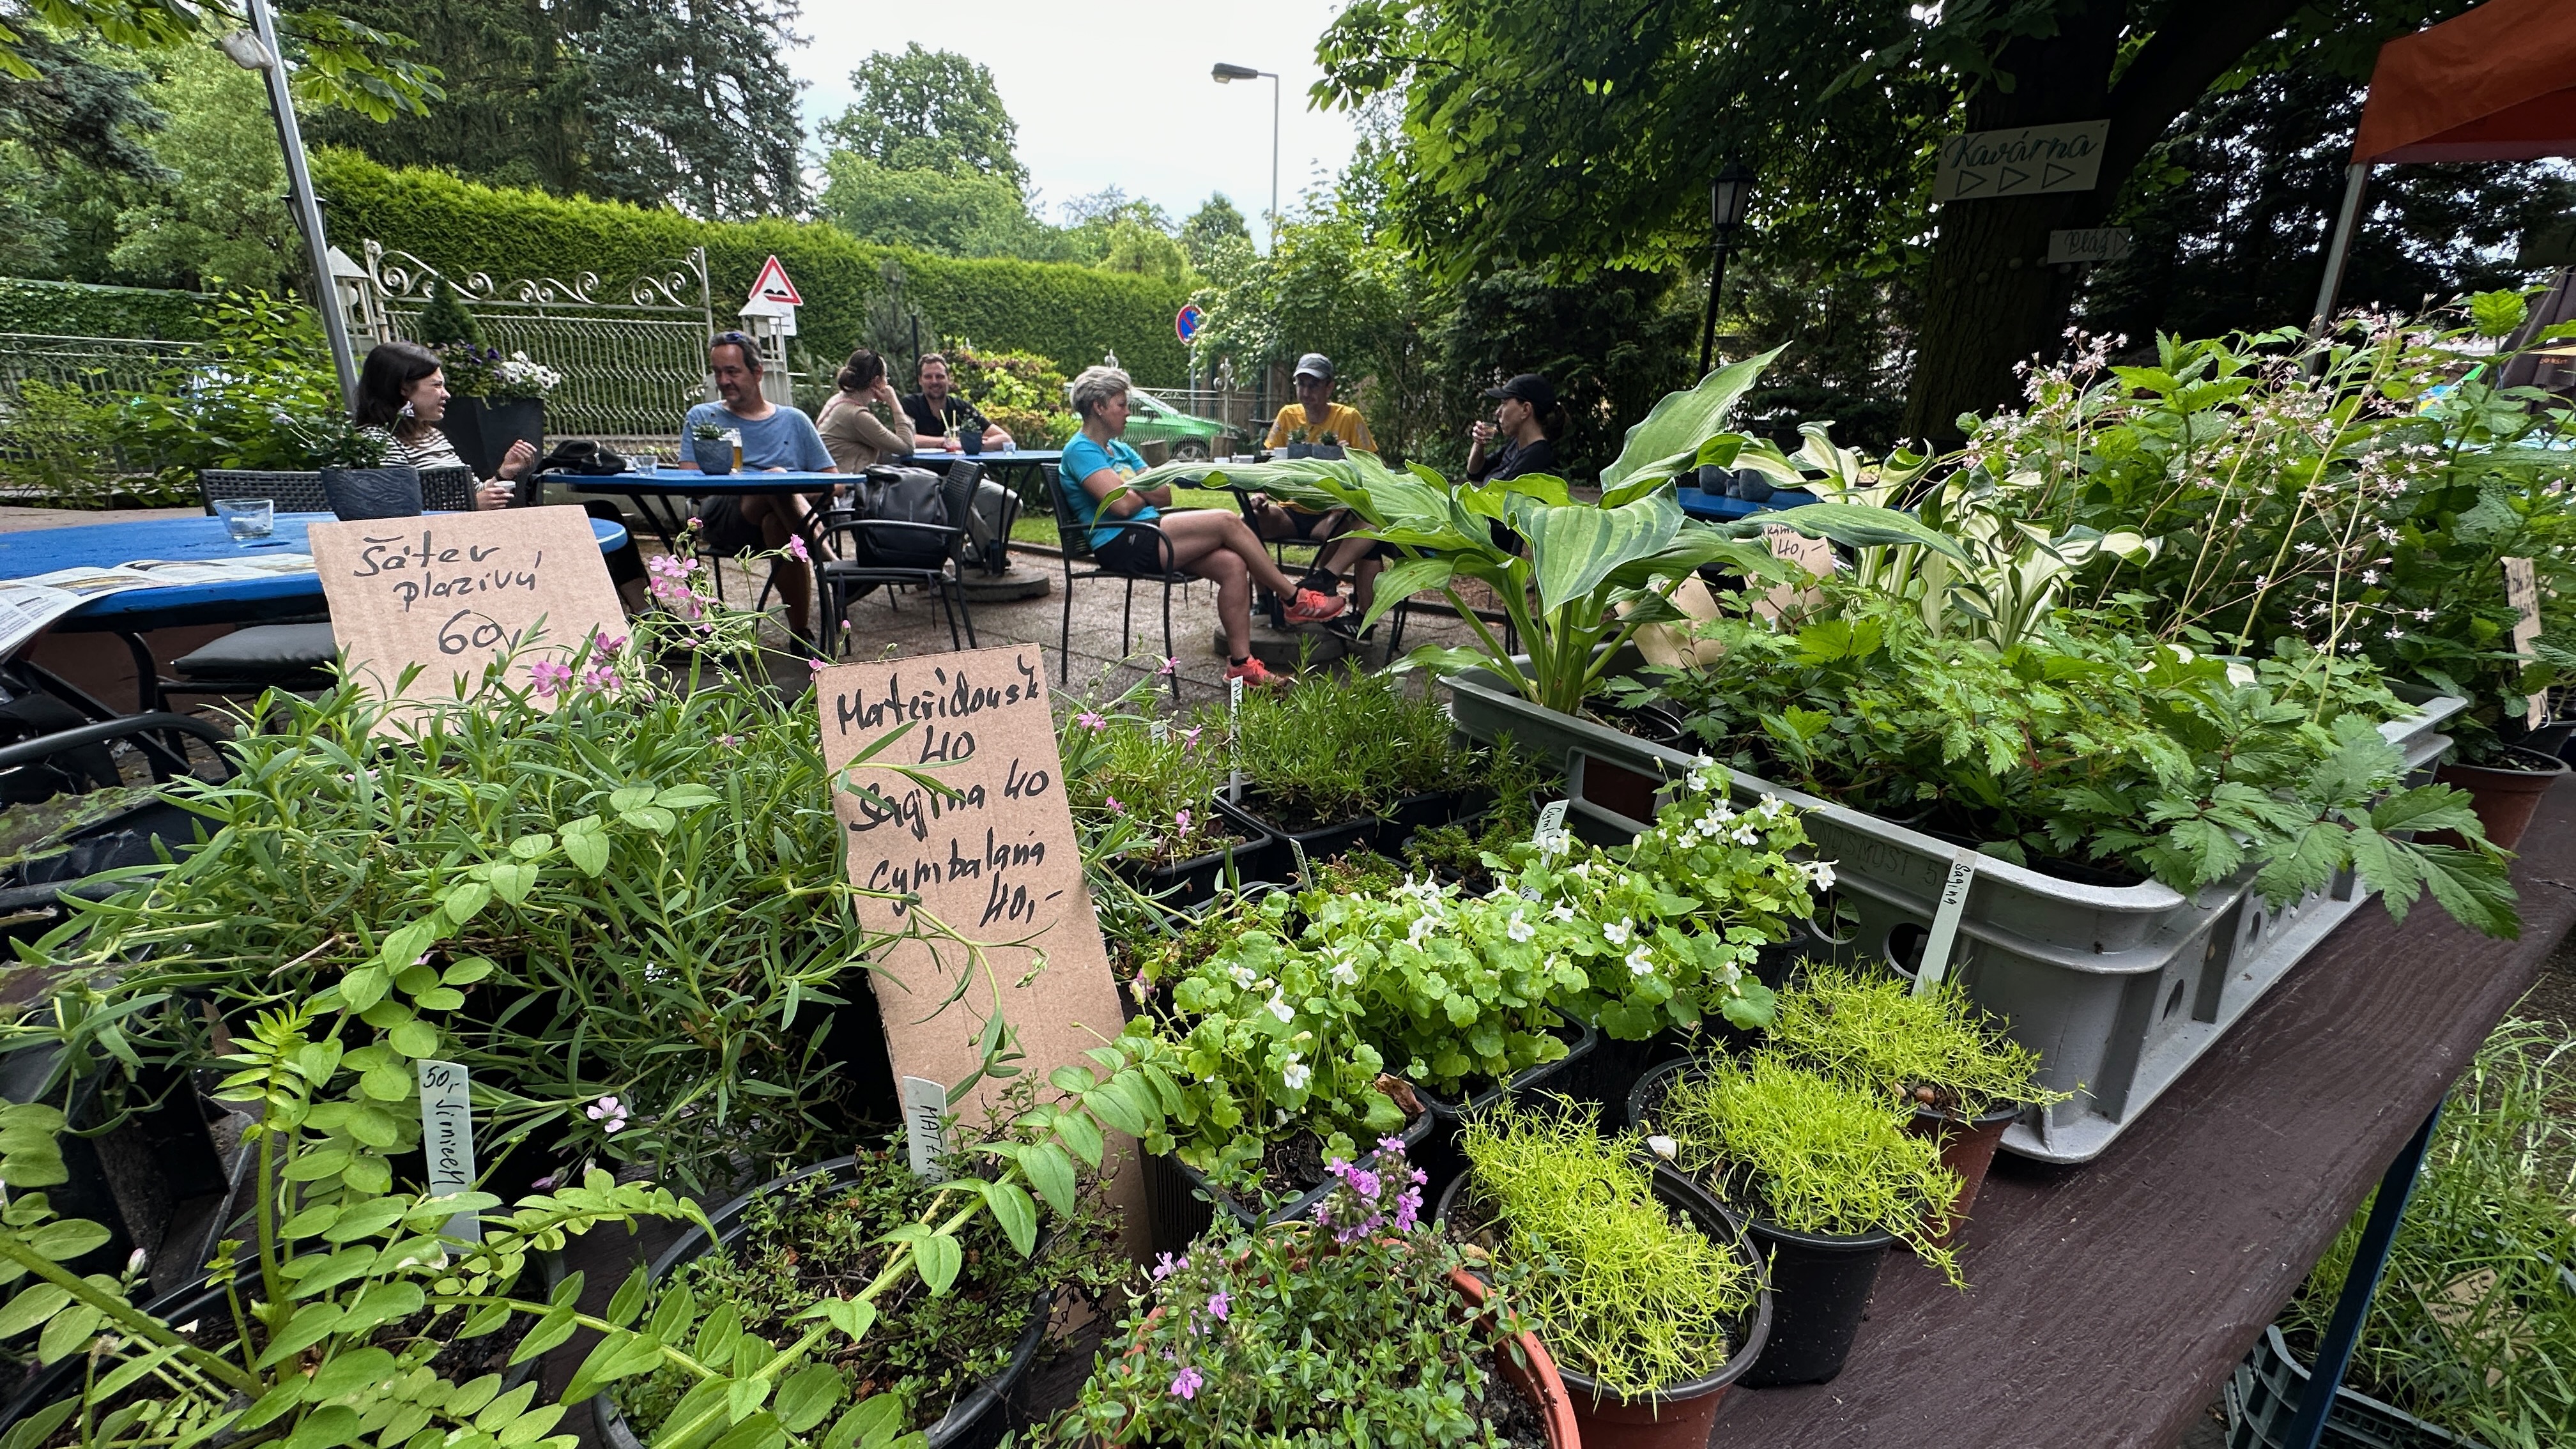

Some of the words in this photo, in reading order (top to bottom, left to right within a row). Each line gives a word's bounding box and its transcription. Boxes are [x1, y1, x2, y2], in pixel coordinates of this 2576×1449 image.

[1945, 130, 2097, 169] Kavárna
[353, 530, 500, 577] Šáter
[1777, 539, 1825, 561] 40,-
[919, 724, 976, 763] 40
[1004, 758, 1050, 799] 40
[979, 871, 1063, 927] 40,-
[1943, 863, 1971, 905] Sagina
[424, 1066, 460, 1093] 50,-
